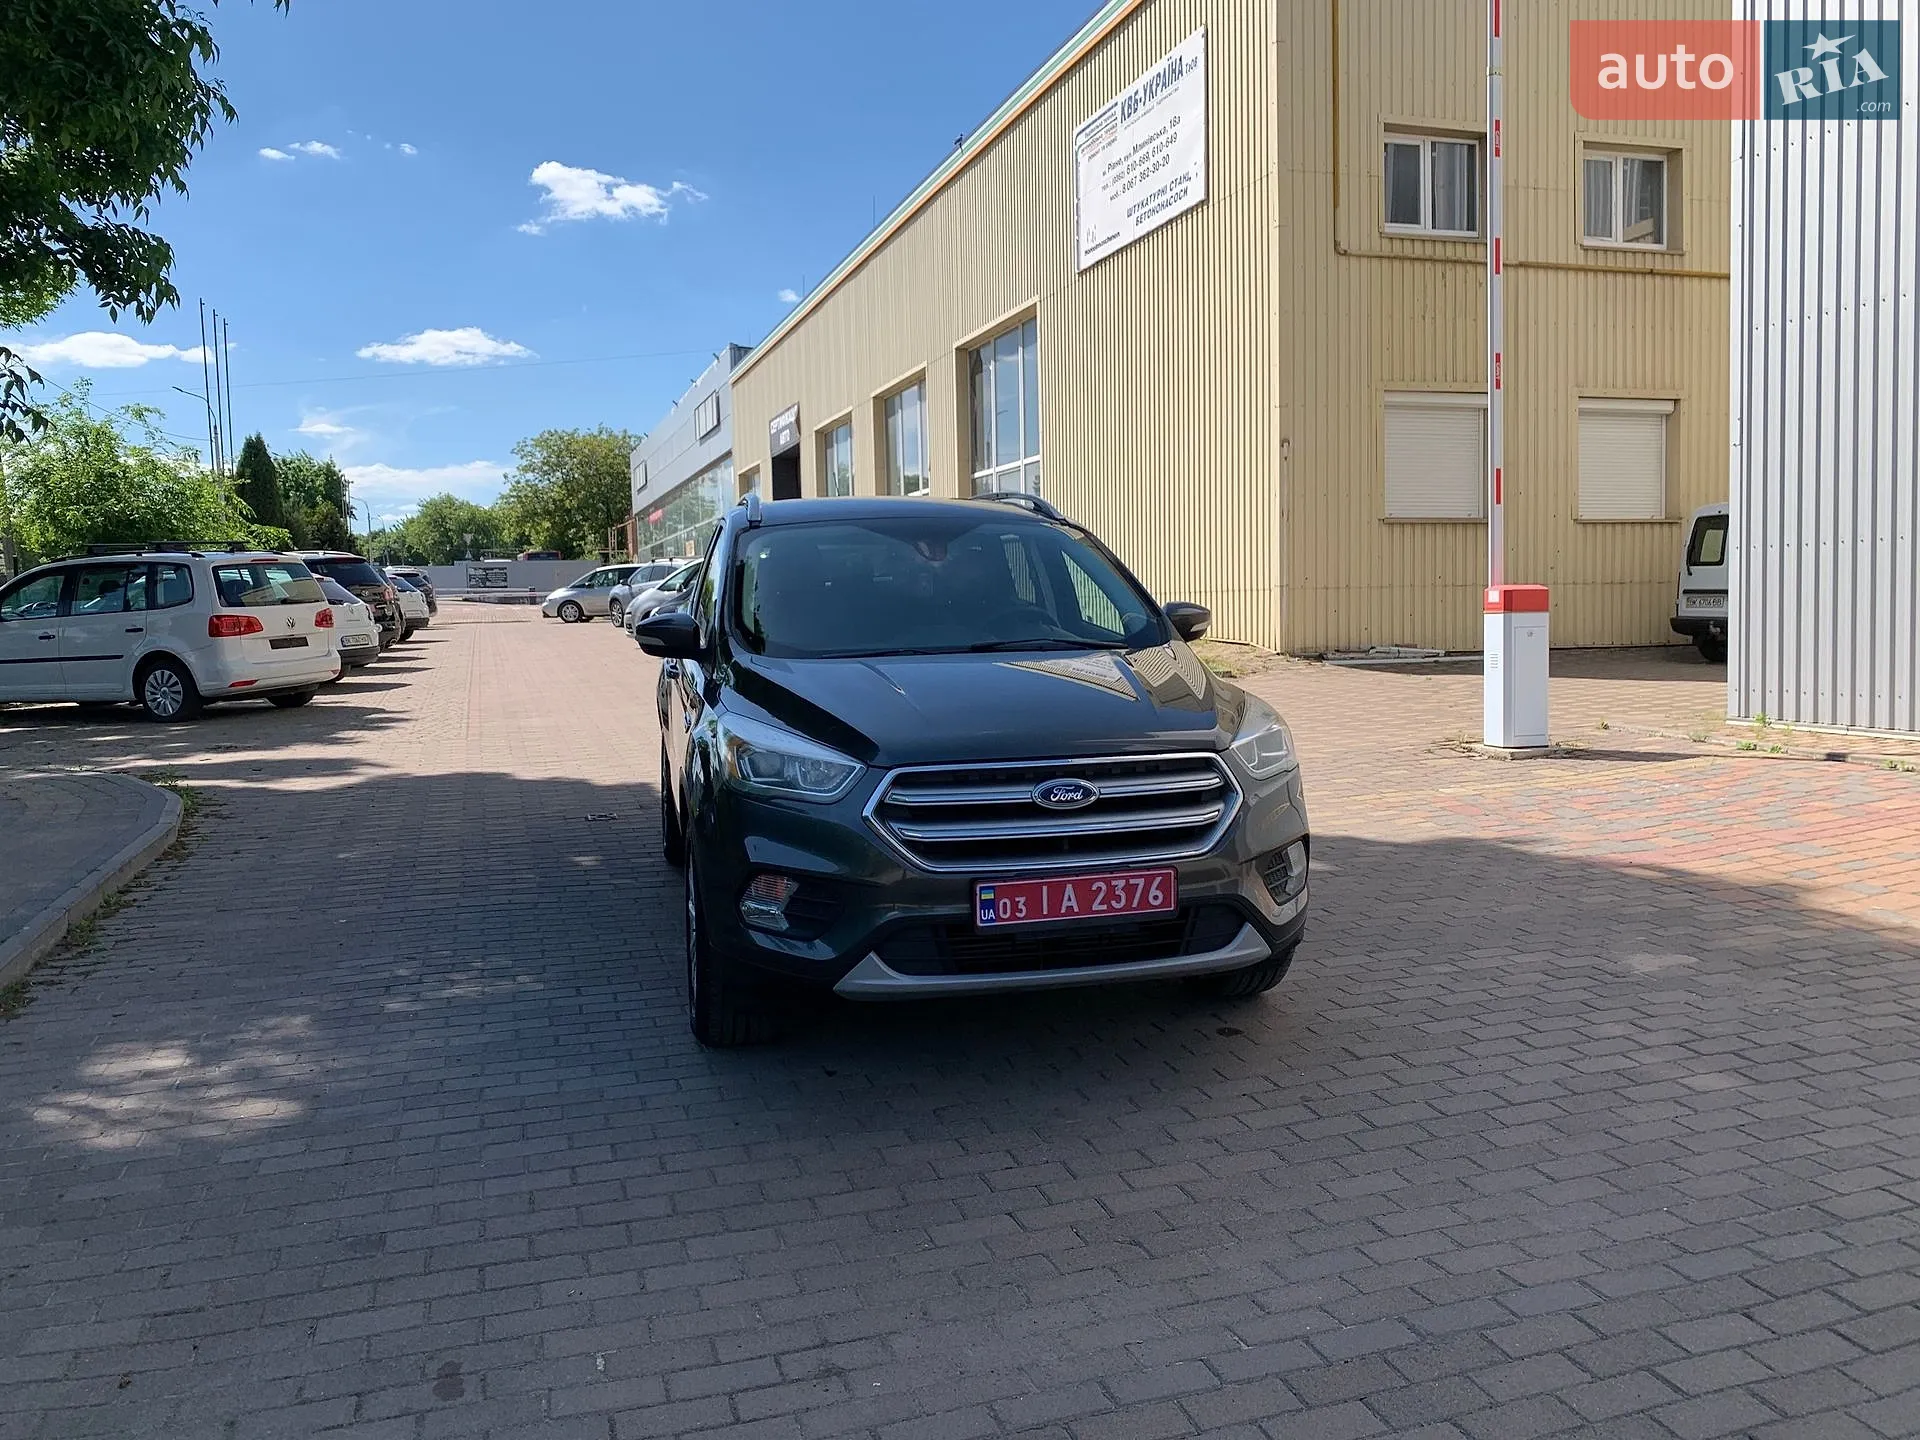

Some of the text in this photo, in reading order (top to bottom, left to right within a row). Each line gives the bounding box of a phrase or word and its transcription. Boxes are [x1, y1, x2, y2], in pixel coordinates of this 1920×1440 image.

[1120, 55, 1183, 124] КВБ-УКРАЇНА
[1135, 185, 1189, 227] БЕТОНОНАСОСИ
[1050, 786, 1083, 802] Ford
[981, 909, 995, 920] UA
[999, 896, 1027, 919] 03
[1091, 876, 1164, 911] 2376
